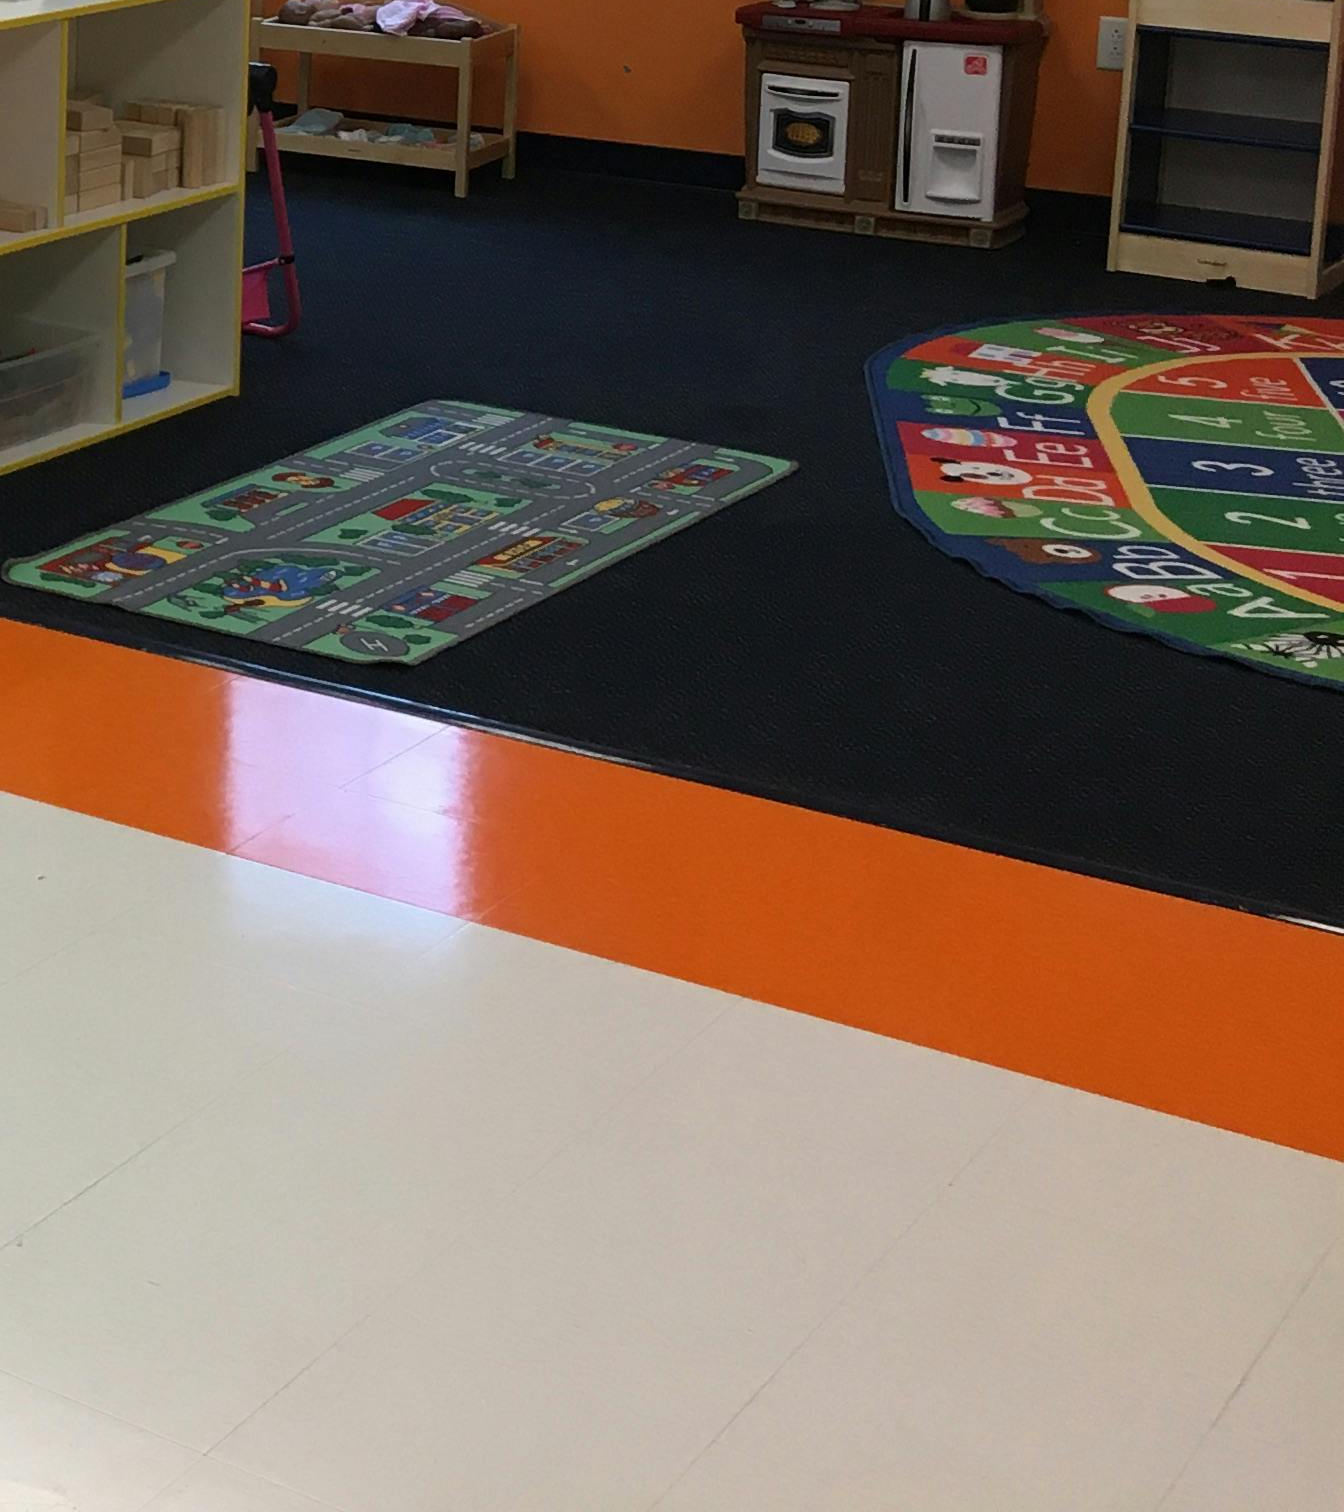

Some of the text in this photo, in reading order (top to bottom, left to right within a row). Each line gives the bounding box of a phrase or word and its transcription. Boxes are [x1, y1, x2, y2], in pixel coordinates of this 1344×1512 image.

[1158, 374, 1298, 402] 5 five
[1167, 410, 1317, 442] 4 four
[1005, 441, 1094, 469] Ee
[1191, 459, 1276, 477] 3
[1021, 474, 1116, 508] Dd
[1039, 506, 1142, 539] Cc
[1224, 510, 1312, 530] 2
[1112, 544, 1223, 580] Bb
[1186, 582, 1331, 620] Aa
